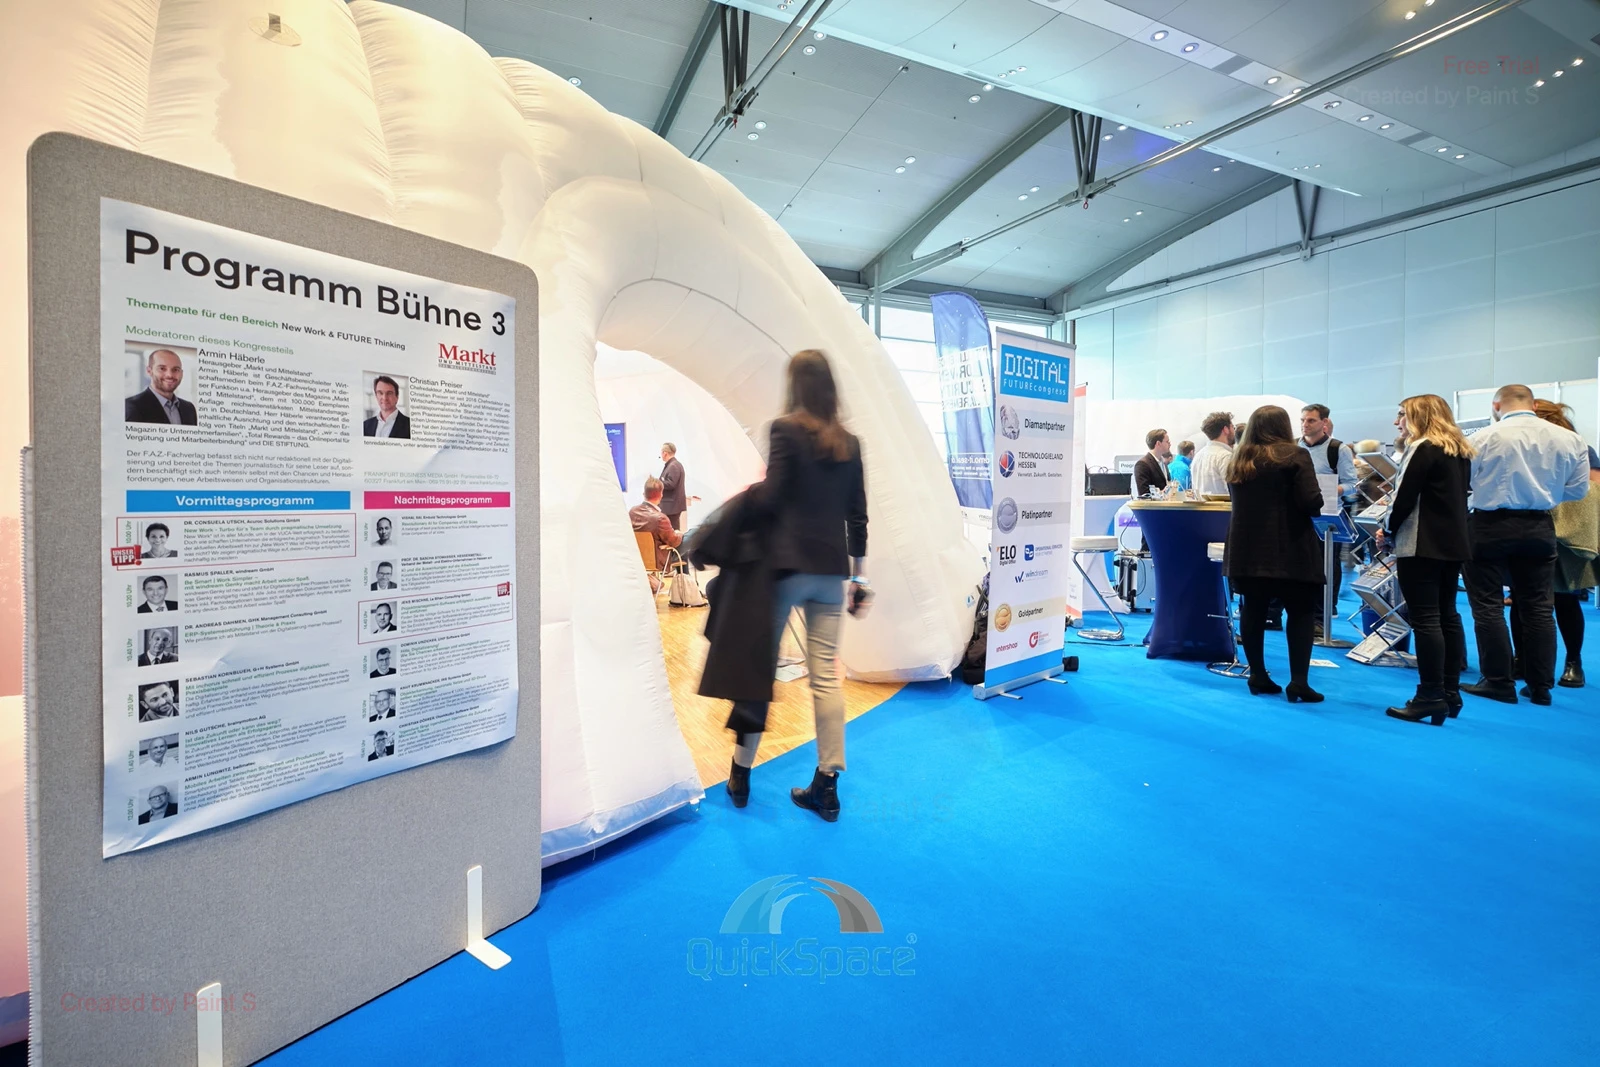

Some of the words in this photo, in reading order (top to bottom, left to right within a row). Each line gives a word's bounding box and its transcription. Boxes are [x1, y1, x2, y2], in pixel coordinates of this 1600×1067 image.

[125, 228, 362, 308] Programm
[378, 285, 482, 332] Bühne
[492, 311, 506, 337] 3
[126, 297, 198, 316] Themenpate
[201, 309, 216, 319] für
[220, 312, 239, 322] den
[242, 315, 279, 329] Bereich
[281, 322, 302, 333] New
[304, 326, 326, 337] Work
[337, 331, 372, 344] FUTURE
[374, 338, 406, 351] Thinking
[125, 325, 195, 341] Moderatoren
[198, 334, 231, 346] dieses
[233, 339, 294, 355] Kongressteils
[199, 349, 226, 359] Armin
[230, 352, 265, 364] Häberle
[438, 343, 496, 367] Markt
[199, 359, 241, 370] Herausgeber
[1004, 352, 1066, 385] DIGITAL
[199, 366, 218, 374] Armin
[223, 369, 248, 377] Häberle
[248, 379, 263, 387] beim
[410, 377, 438, 386] Christian
[440, 380, 462, 388] Preiser
[1003, 378, 1066, 396] FUTUREcongress
[211, 384, 237, 392] Funktion
[253, 388, 291, 398] Herausgeber
[234, 416, 270, 426] Ausrichtung
[1024, 418, 1066, 432] Diamantpartner
[126, 425, 157, 435] Magazin
[126, 433, 164, 443] Vergütung
[1018, 451, 1063, 461] TECHNOLOGIELAND
[1018, 461, 1037, 469] HESSEN
[176, 495, 314, 508] Vormittagsprogramm
[394, 495, 492, 509] Nachmittagsprogramm
[1021, 510, 1052, 520] Platinpartner
[1000, 545, 1016, 561] ELO
[1025, 569, 1048, 578] windream
[1018, 607, 1043, 618] Goldpartner
[996, 641, 1018, 653] intershop
